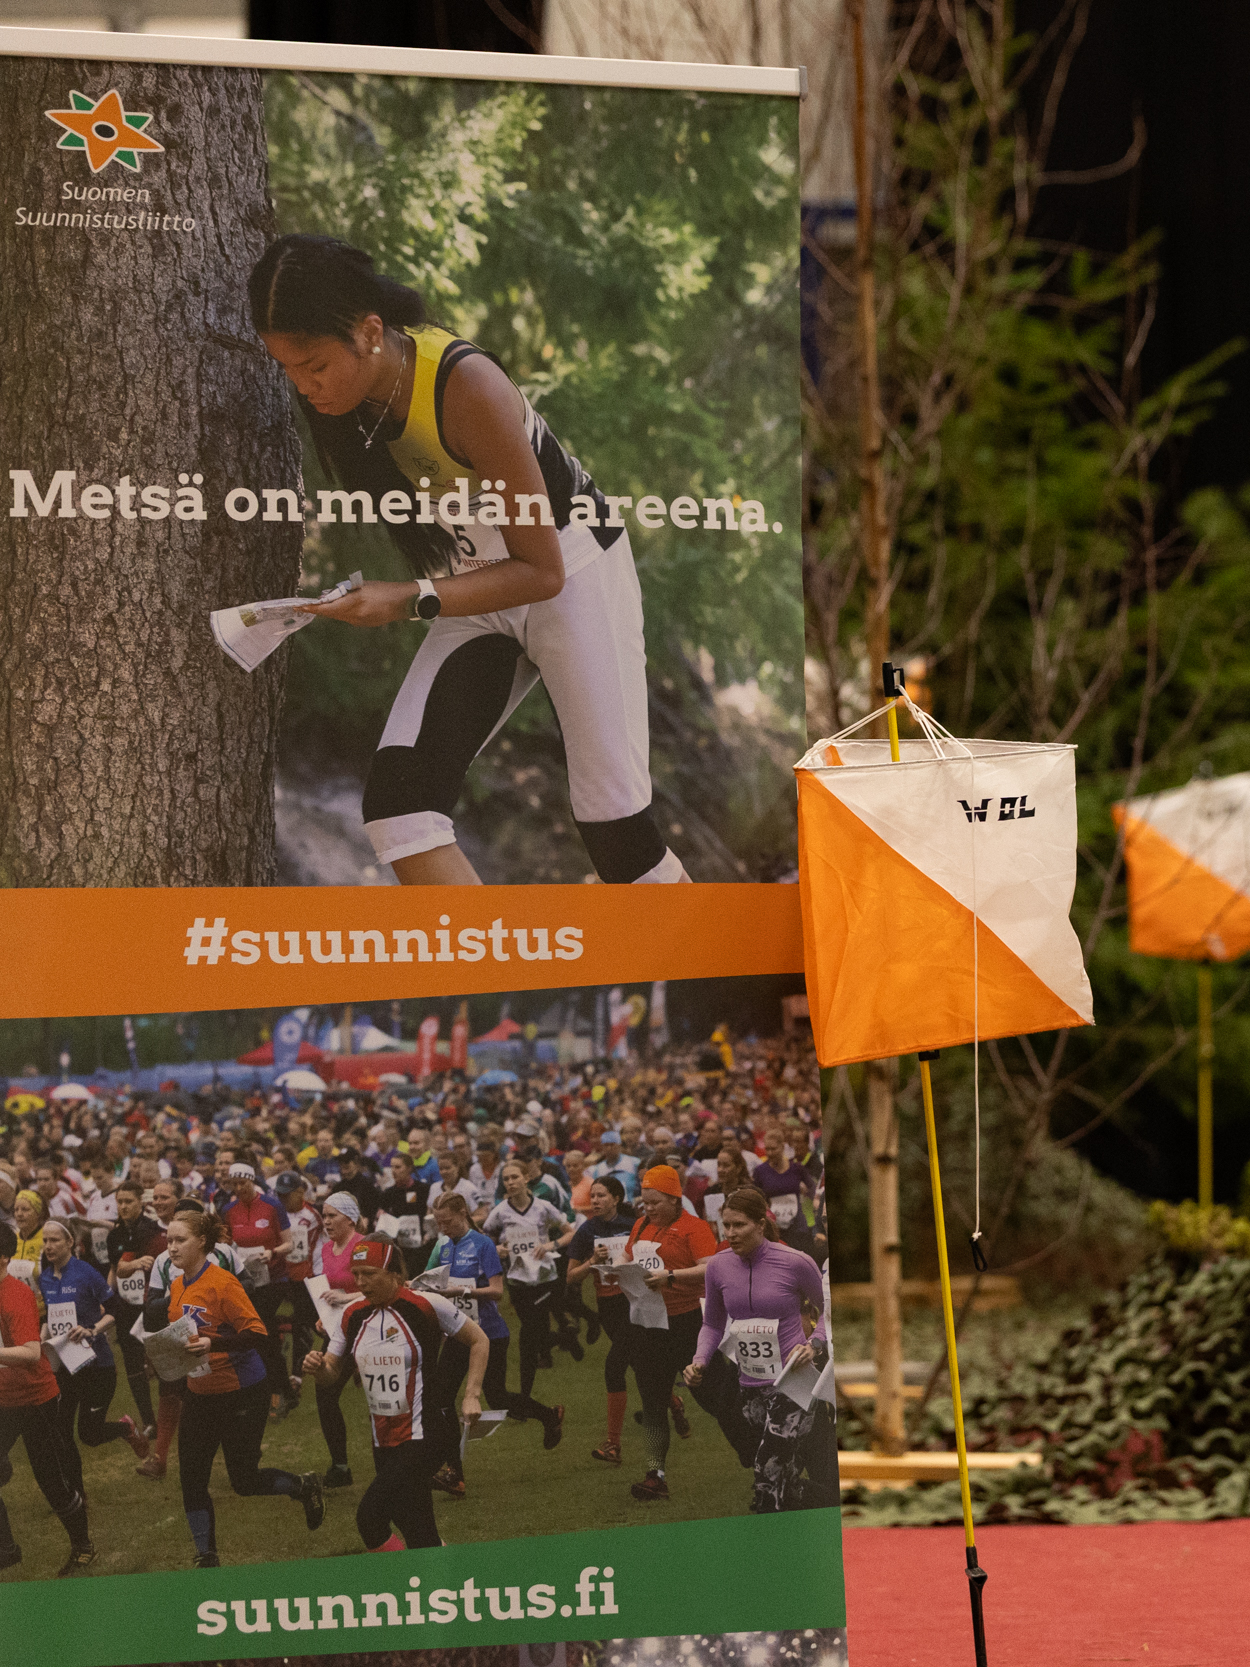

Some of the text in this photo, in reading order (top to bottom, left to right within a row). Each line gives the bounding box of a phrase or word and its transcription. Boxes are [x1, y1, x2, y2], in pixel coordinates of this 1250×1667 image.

[62, 181, 150, 202] Suomen
[15, 207, 195, 231] Suunnistusliitto
[9, 470, 783, 533] Metsä on meidän areena.
[183, 914, 584, 965] #suunnistus
[121, 1279, 145, 1291] 608
[747, 1325, 774, 1334] LIETO
[738, 1341, 773, 1358] 833
[373, 1356, 401, 1366] LIETO
[364, 1374, 400, 1392] 716
[197, 1566, 619, 1635] suunnistus.fi
